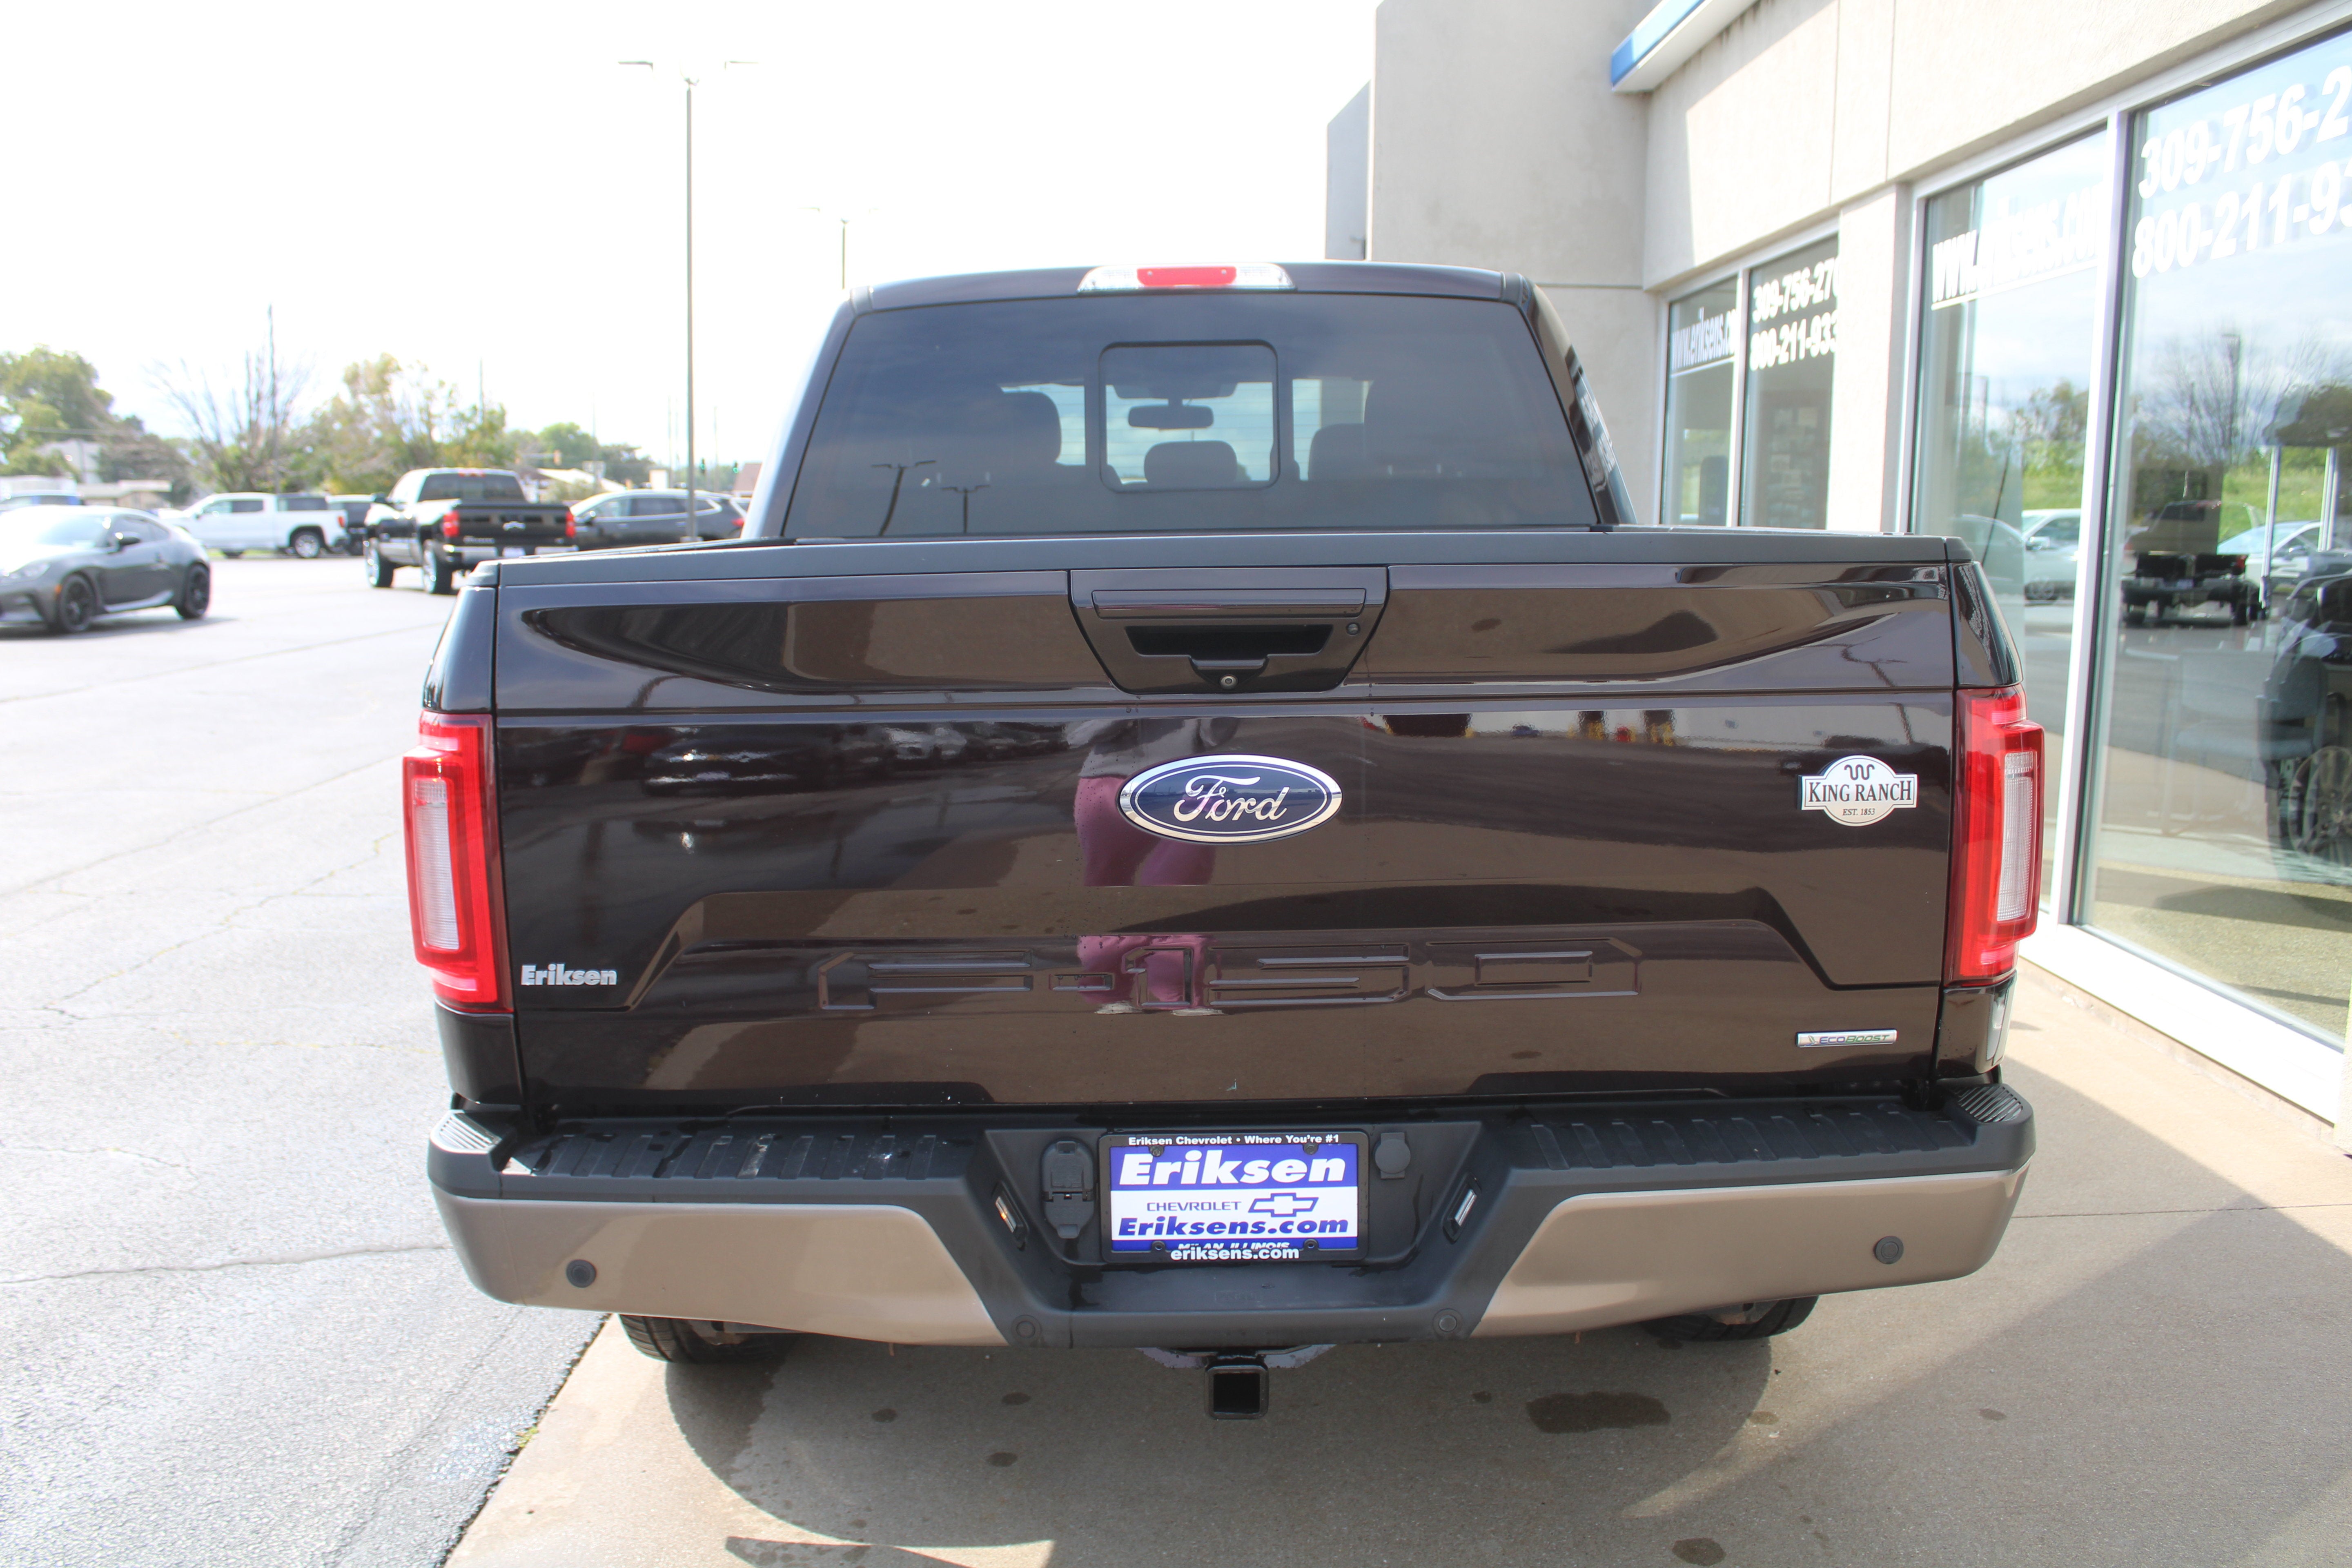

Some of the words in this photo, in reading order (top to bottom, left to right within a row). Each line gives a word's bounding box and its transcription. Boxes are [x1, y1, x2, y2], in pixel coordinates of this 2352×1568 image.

[2138, 65, 2352, 199] 309-756-2
[1173, 775, 1290, 822] Ford
[1809, 782, 1850, 802] KING
[1855, 780, 1912, 802] RANCH
[521, 964, 617, 985] Eriksen
[1128, 1136, 1173, 1146] Eriksen
[1176, 1136, 1232, 1145] Chevrolet
[1244, 1135, 1282, 1144] Where
[1286, 1135, 1322, 1144] You're
[1325, 1134, 1339, 1143] #1
[1119, 1150, 1346, 1185] Eriksen
[1147, 1201, 1242, 1212] CHEVROLET
[1118, 1216, 1348, 1236] Eriksens.com
[1170, 1246, 1300, 1261] eriksens.com
